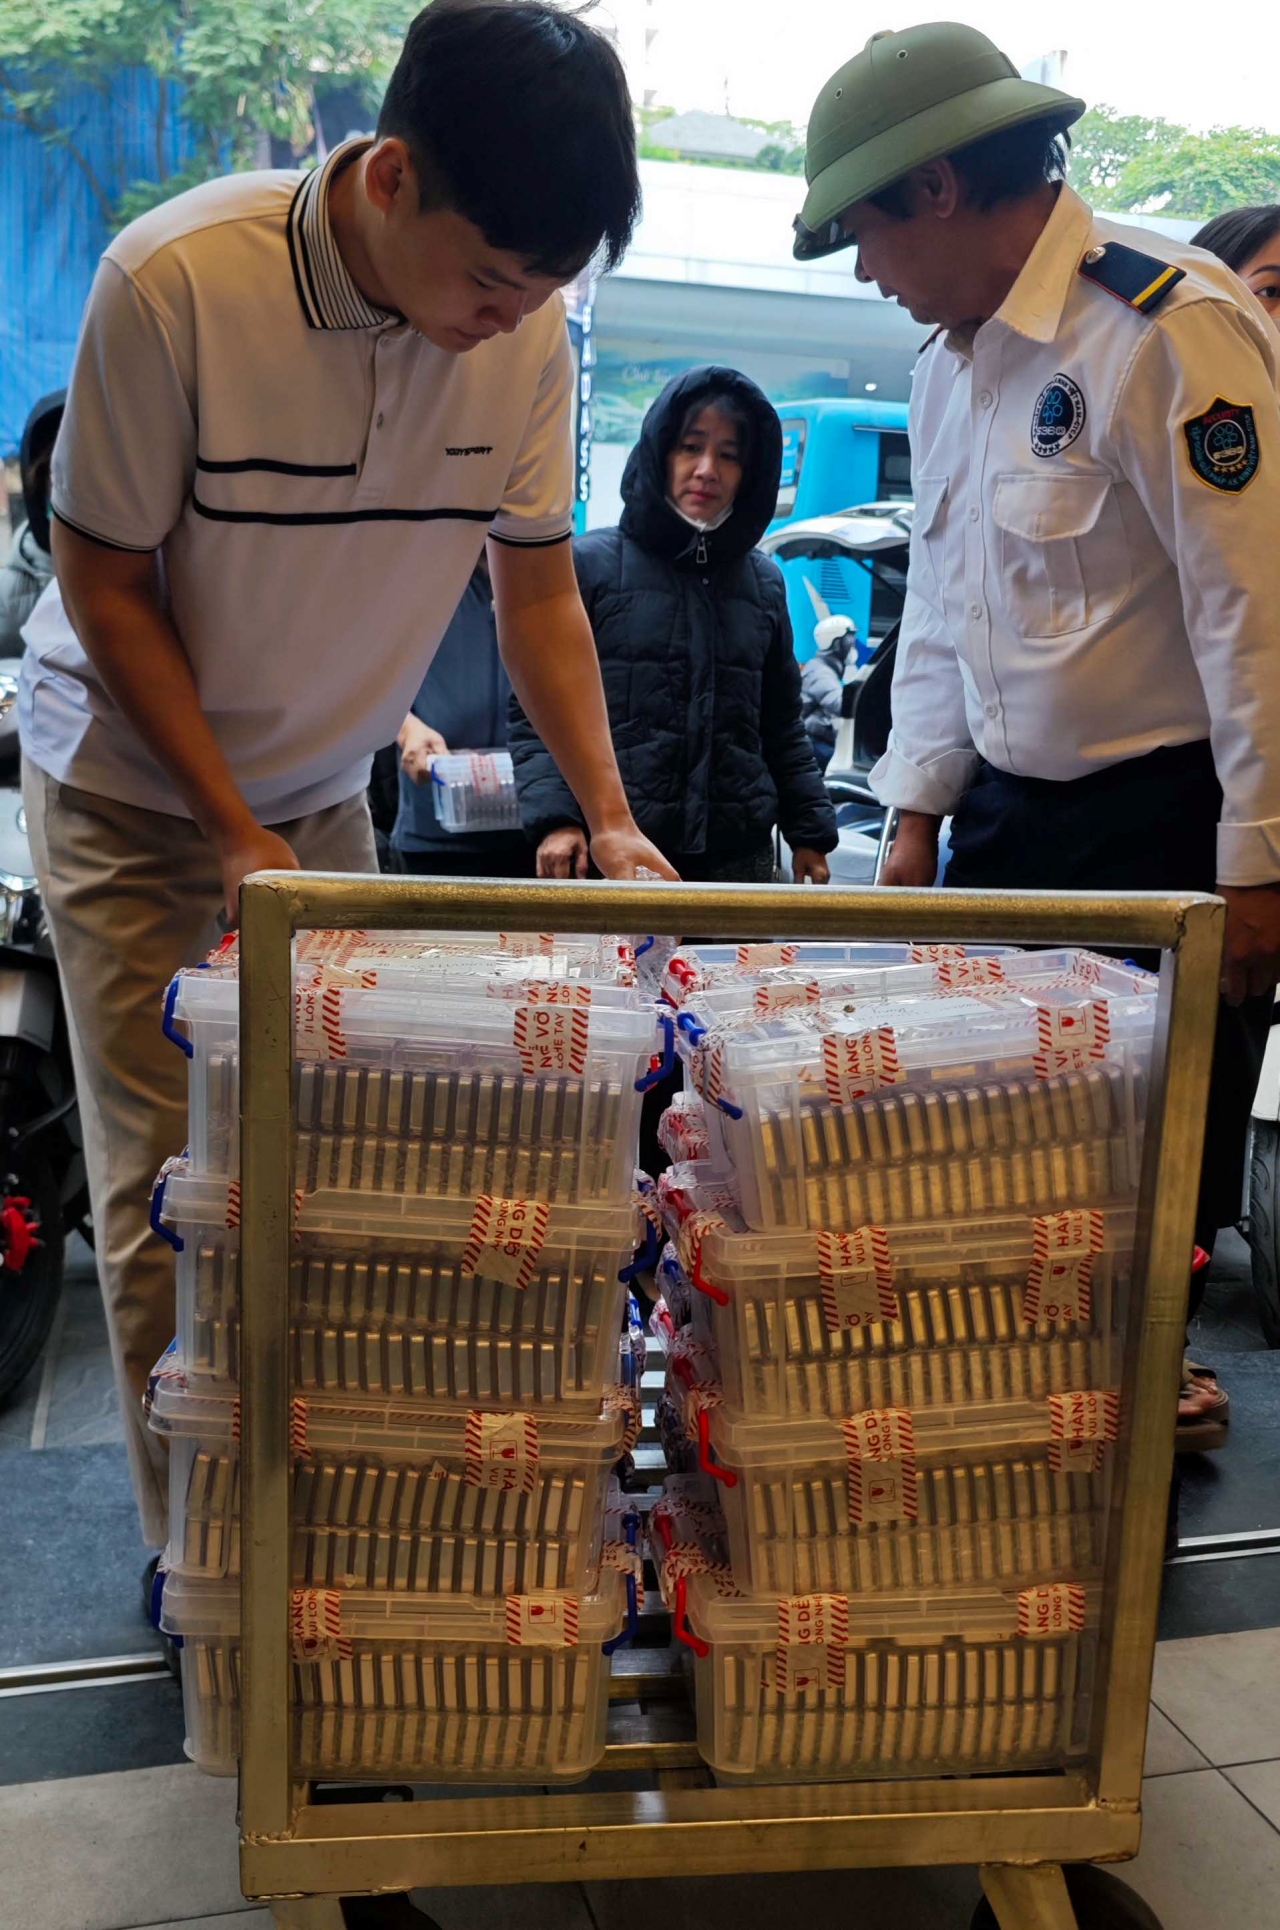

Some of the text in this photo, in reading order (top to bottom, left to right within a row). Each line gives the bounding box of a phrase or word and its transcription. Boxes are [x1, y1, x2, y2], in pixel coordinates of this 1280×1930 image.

[533, 1011, 550, 1038] VỠ
[555, 1012, 564, 1036] TAY
[1074, 1225, 1082, 1245] VUI
[856, 1243, 866, 1264] VUI
[1067, 1393, 1084, 1439] HÀNG
[1088, 1417, 1097, 1437] VUI
[488, 1468, 499, 1486] VUI
[502, 1468, 518, 1491] HÀ
